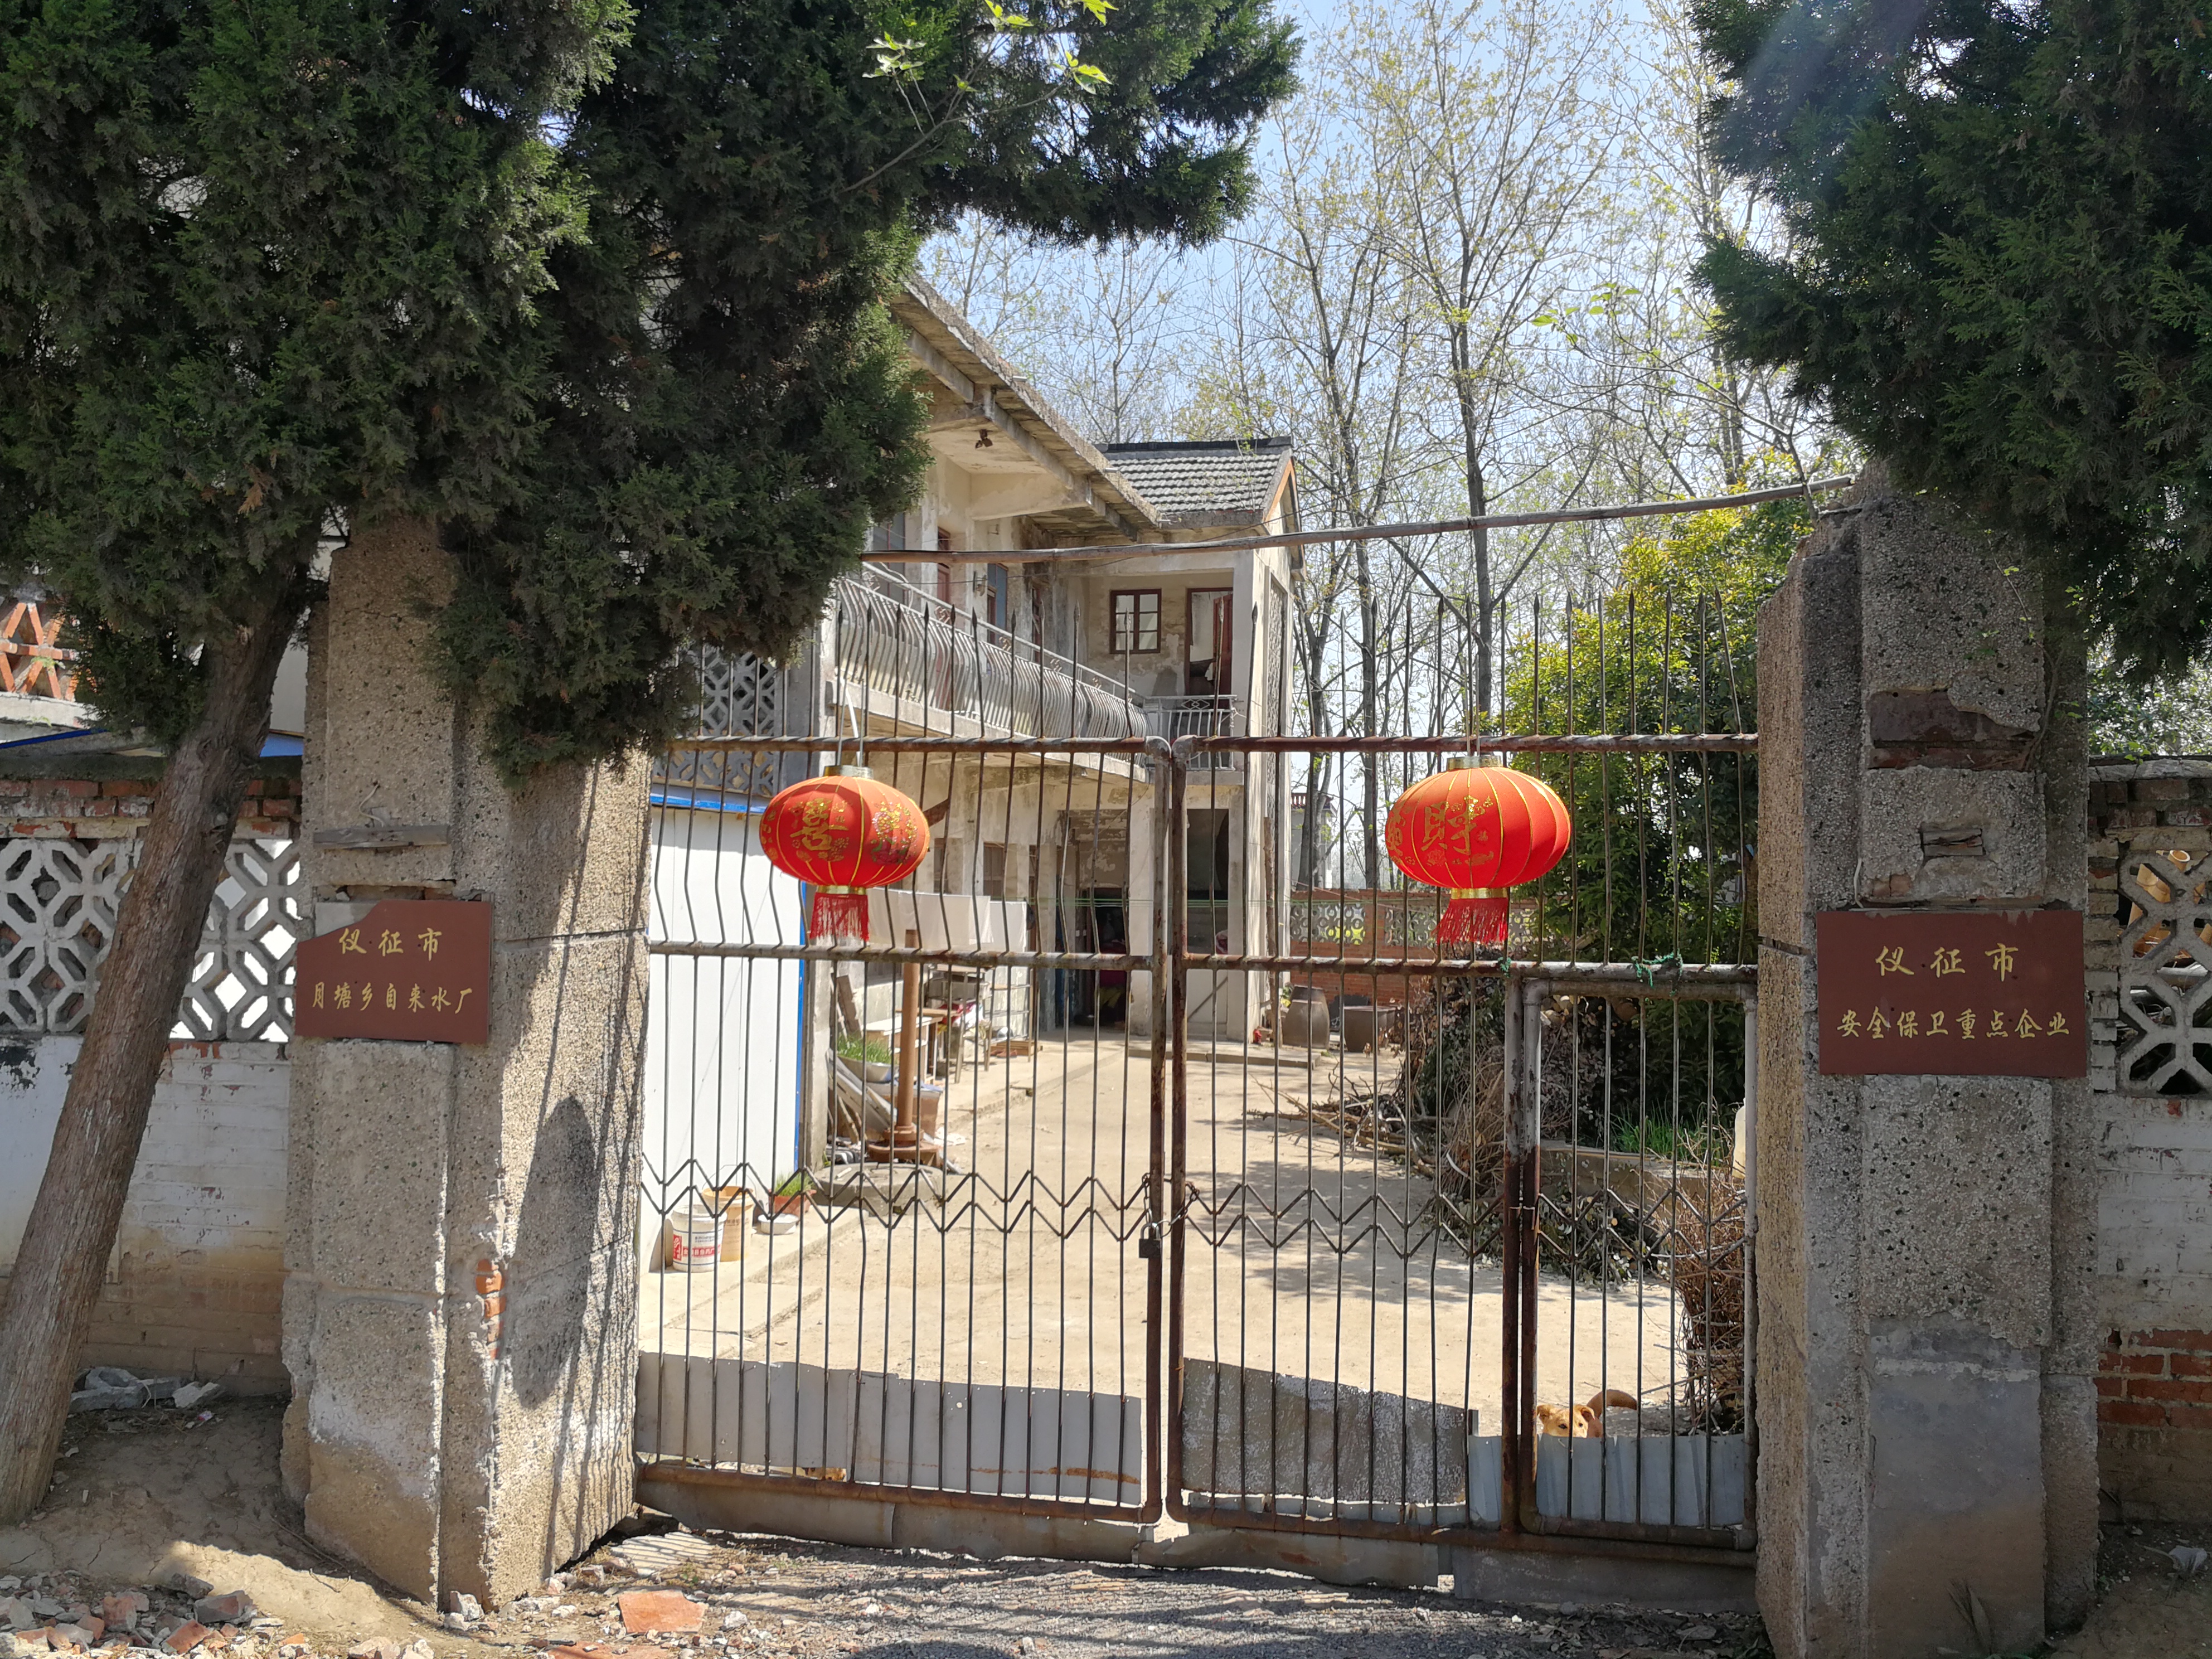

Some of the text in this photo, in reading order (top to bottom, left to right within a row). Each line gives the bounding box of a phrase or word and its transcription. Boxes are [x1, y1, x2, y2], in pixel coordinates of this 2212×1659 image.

[338, 927, 443, 962] 仪征市
[1875, 943, 2019, 982] 仪征市
[312, 981, 473, 1014] 月塘乡自来水厂
[1836, 1006, 2070, 1040] 安全保卫重点企业
